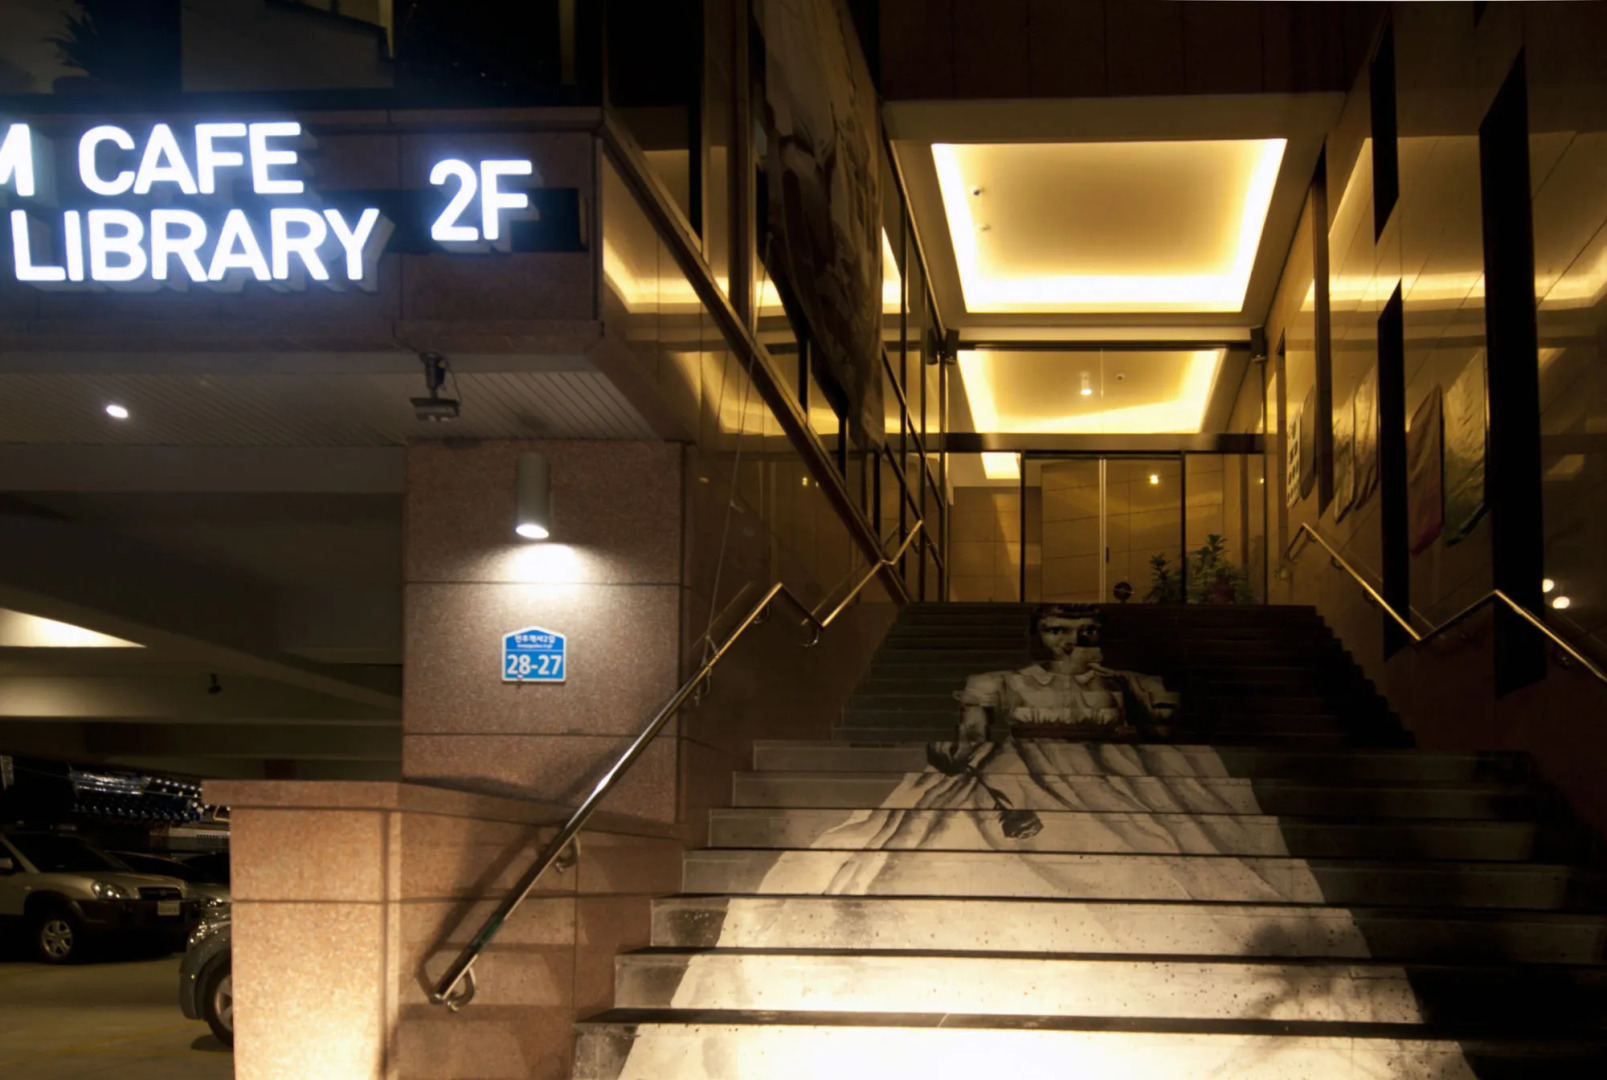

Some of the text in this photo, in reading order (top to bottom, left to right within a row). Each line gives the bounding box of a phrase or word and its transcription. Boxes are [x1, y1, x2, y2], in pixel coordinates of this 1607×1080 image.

[78, 122, 304, 196] CAFE
[429, 158, 533, 241] 2F
[10, 207, 380, 282] LIBRARY
[506, 654, 562, 675] 28-27
